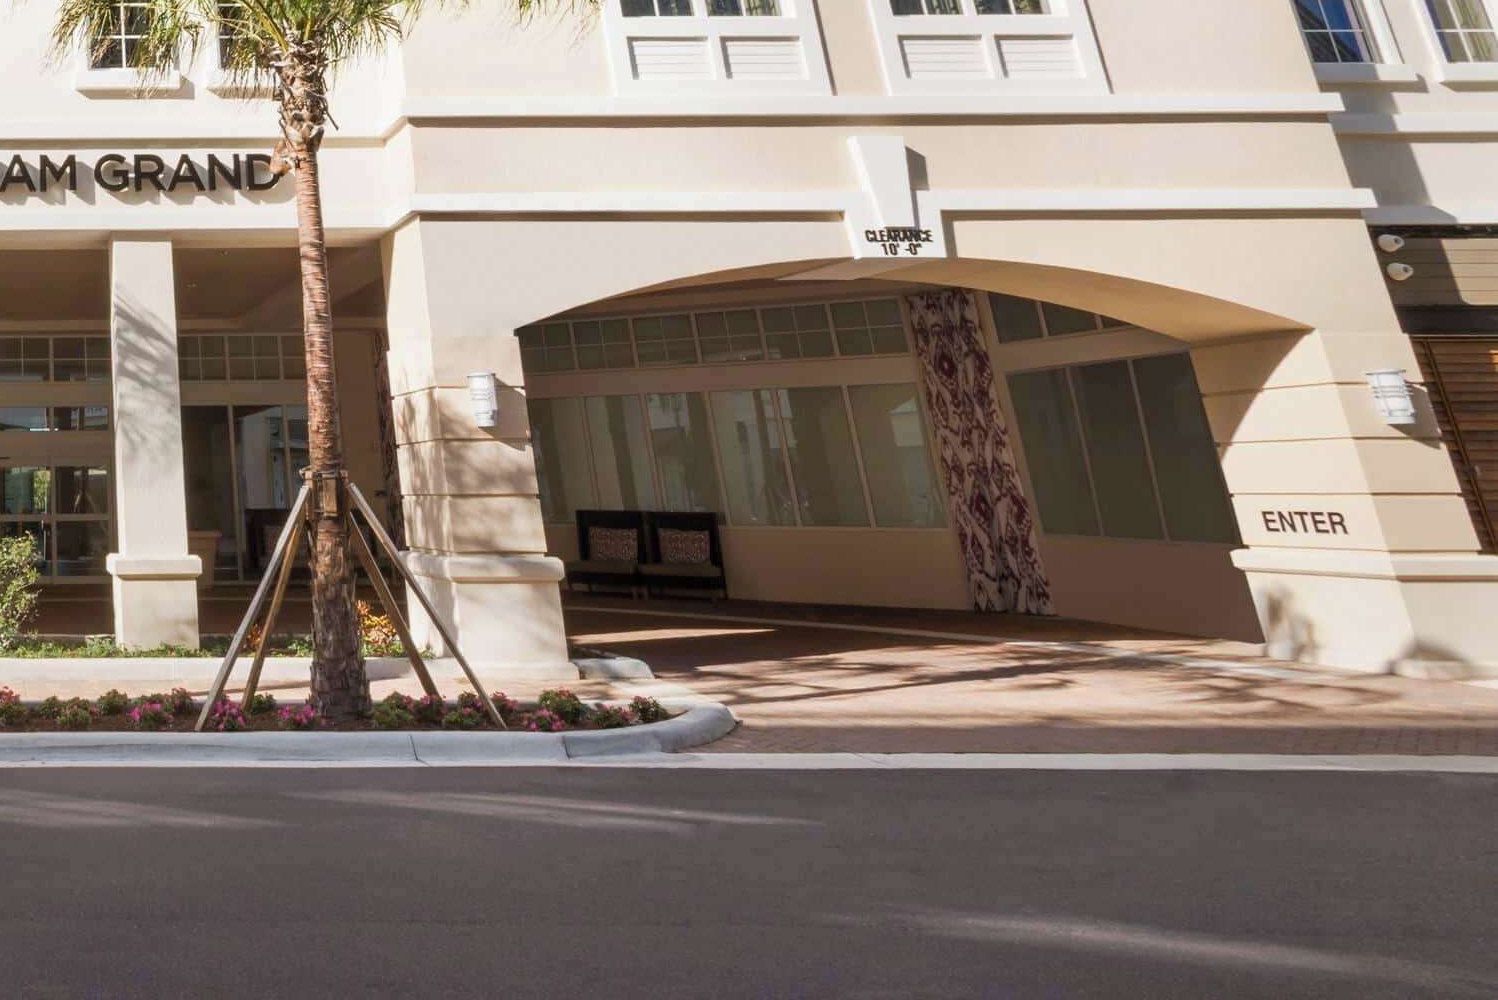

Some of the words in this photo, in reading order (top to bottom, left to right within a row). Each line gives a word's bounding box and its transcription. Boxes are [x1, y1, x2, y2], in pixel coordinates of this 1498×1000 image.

[94, 153, 281, 192] GRAND
[865, 229, 933, 242] CLEARANCE
[1261, 510, 1349, 535] ENTER
